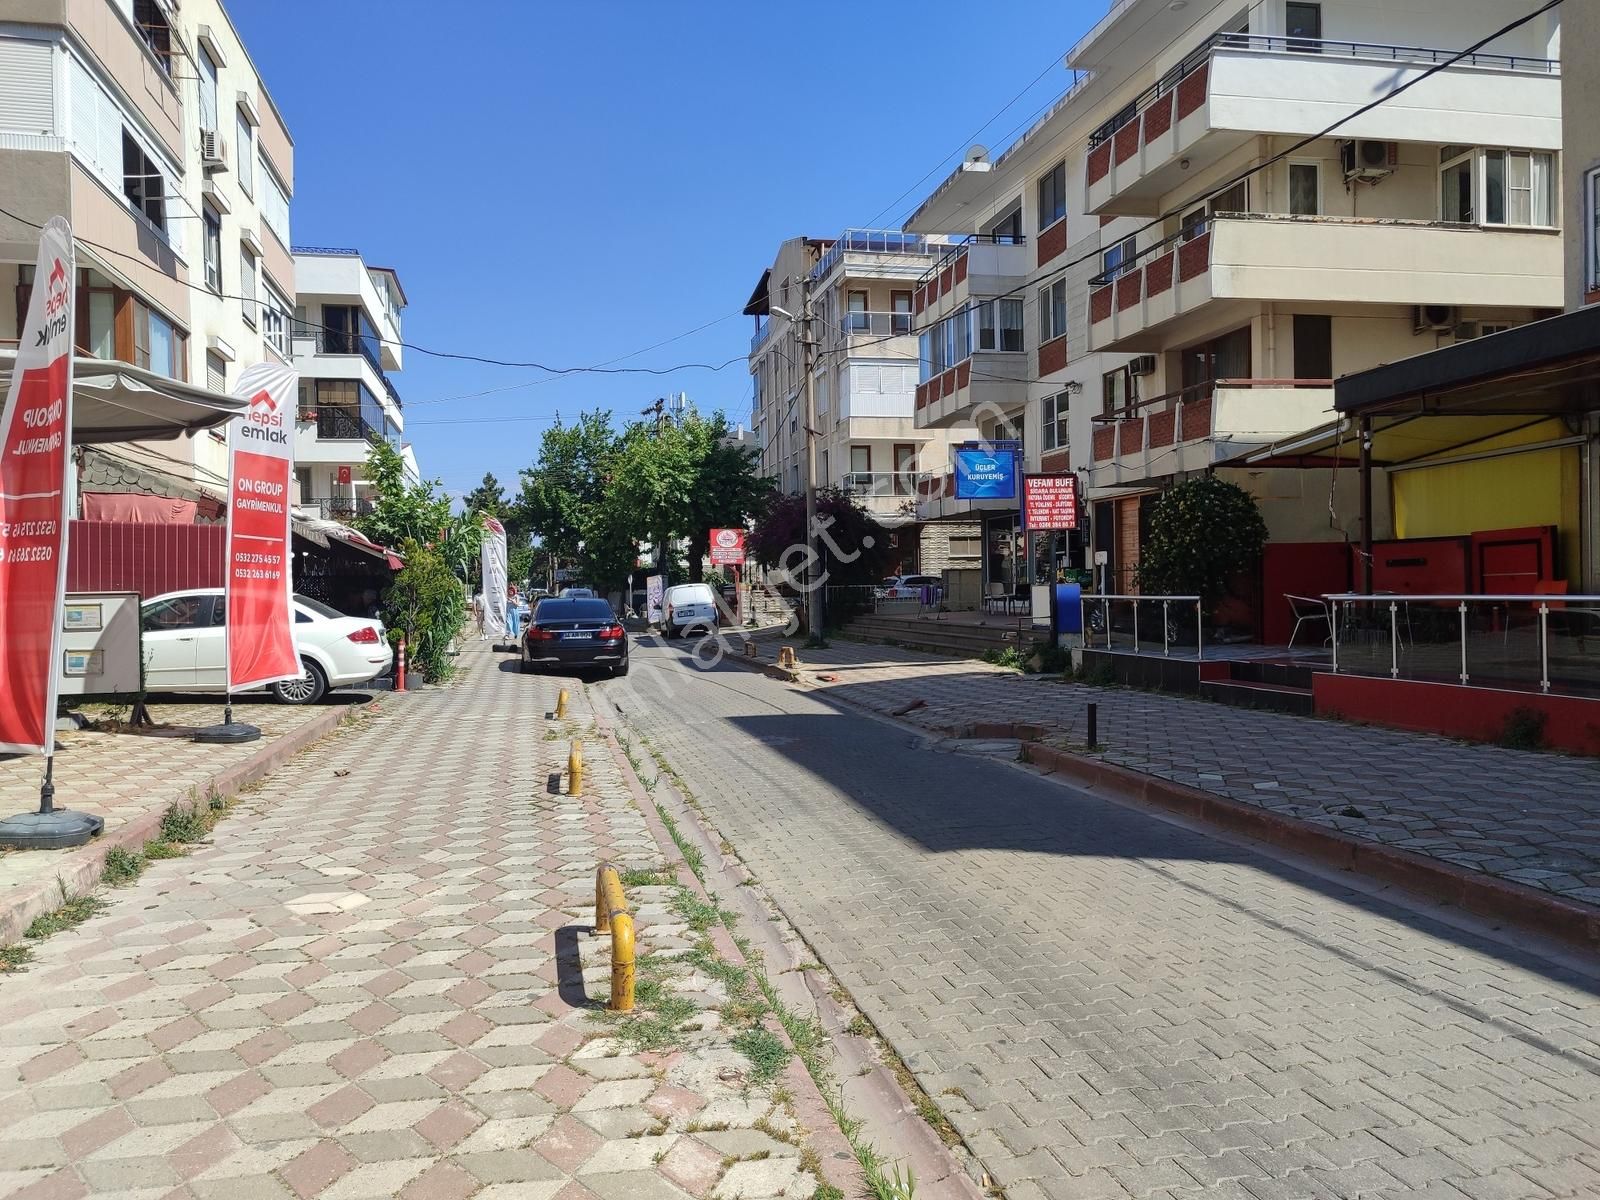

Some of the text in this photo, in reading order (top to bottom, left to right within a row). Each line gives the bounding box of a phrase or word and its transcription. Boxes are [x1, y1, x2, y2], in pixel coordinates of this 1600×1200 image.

[248, 411, 282, 427] epsi
[241, 426, 287, 445] emlak
[975, 463, 996, 472] ÜÇLER
[967, 472, 1004, 481] KURUYEMİŞ
[1028, 478, 1053, 487] VEFAM
[238, 478, 283, 497] ON GROUP
[236, 497, 283, 514] GAYRİMENKUL
[235, 552, 250, 563] 0532
[251, 553, 263, 564] 275
[235, 568, 250, 578] 0532
